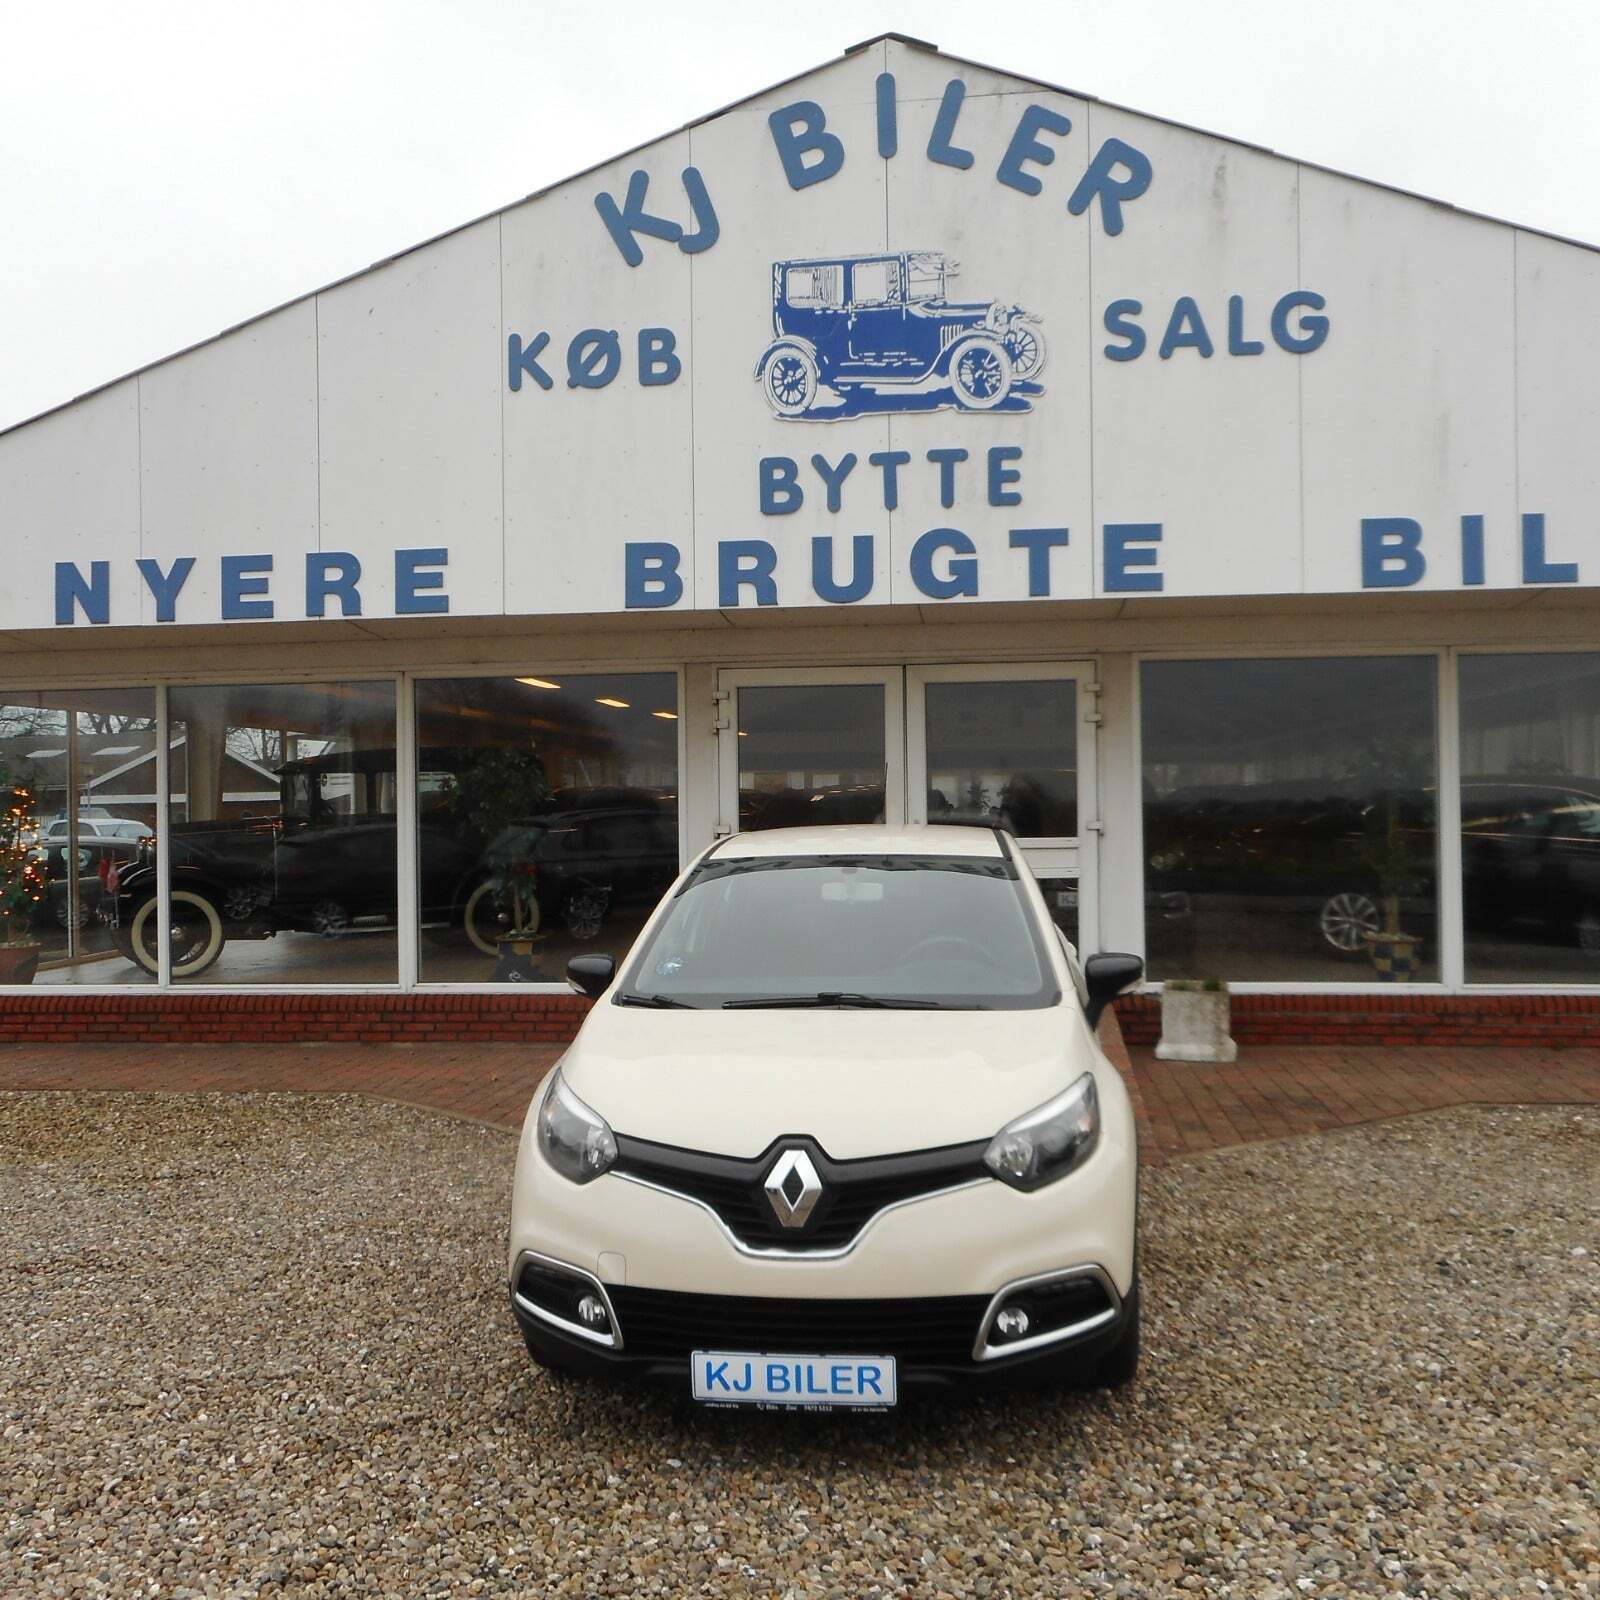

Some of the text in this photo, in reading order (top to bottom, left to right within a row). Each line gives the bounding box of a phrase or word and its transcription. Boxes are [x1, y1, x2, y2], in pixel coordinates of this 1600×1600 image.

[595, 72, 1152, 267] KJ BILER
[509, 326, 681, 392] KØB
[1103, 290, 1330, 362] SALG
[760, 446, 1022, 515] BYTTE
[56, 512, 1578, 630] NYERE BRUGTE BIL
[706, 1361, 883, 1395] KJ BILER
